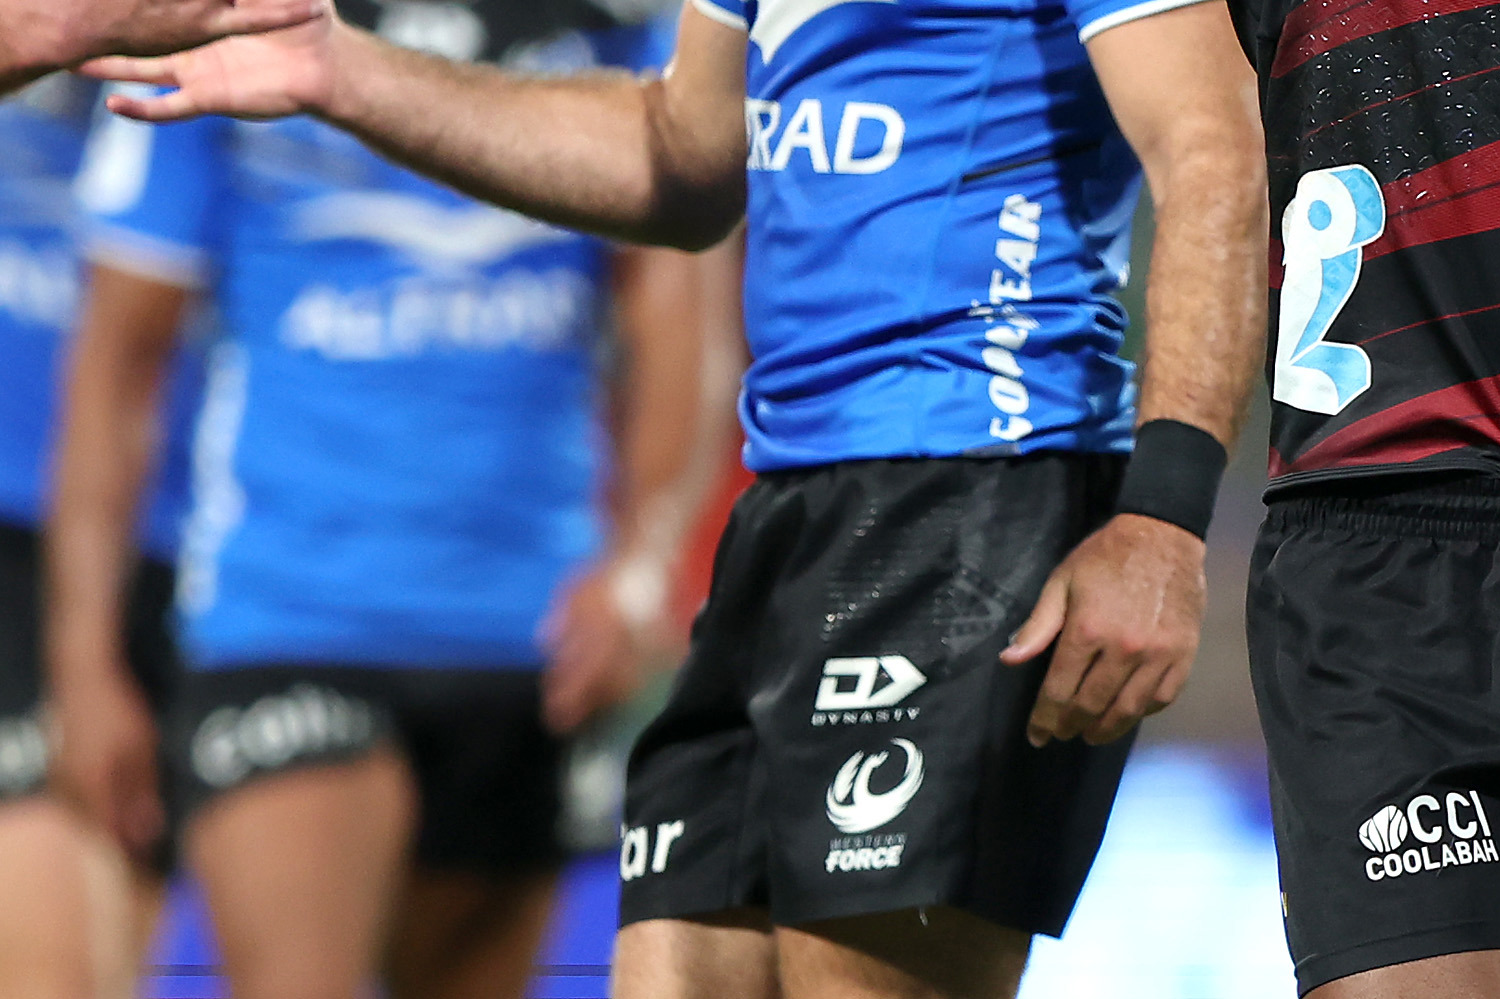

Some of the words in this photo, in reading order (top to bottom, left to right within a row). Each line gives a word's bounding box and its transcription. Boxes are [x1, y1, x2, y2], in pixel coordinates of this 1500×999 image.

[743, 97, 906, 175] RAD
[811, 706, 920, 727] DYNASTY
[1406, 790, 1491, 843] CCI
[825, 845, 905, 873] FORCE
[1365, 839, 1500, 881] COOLABAH
